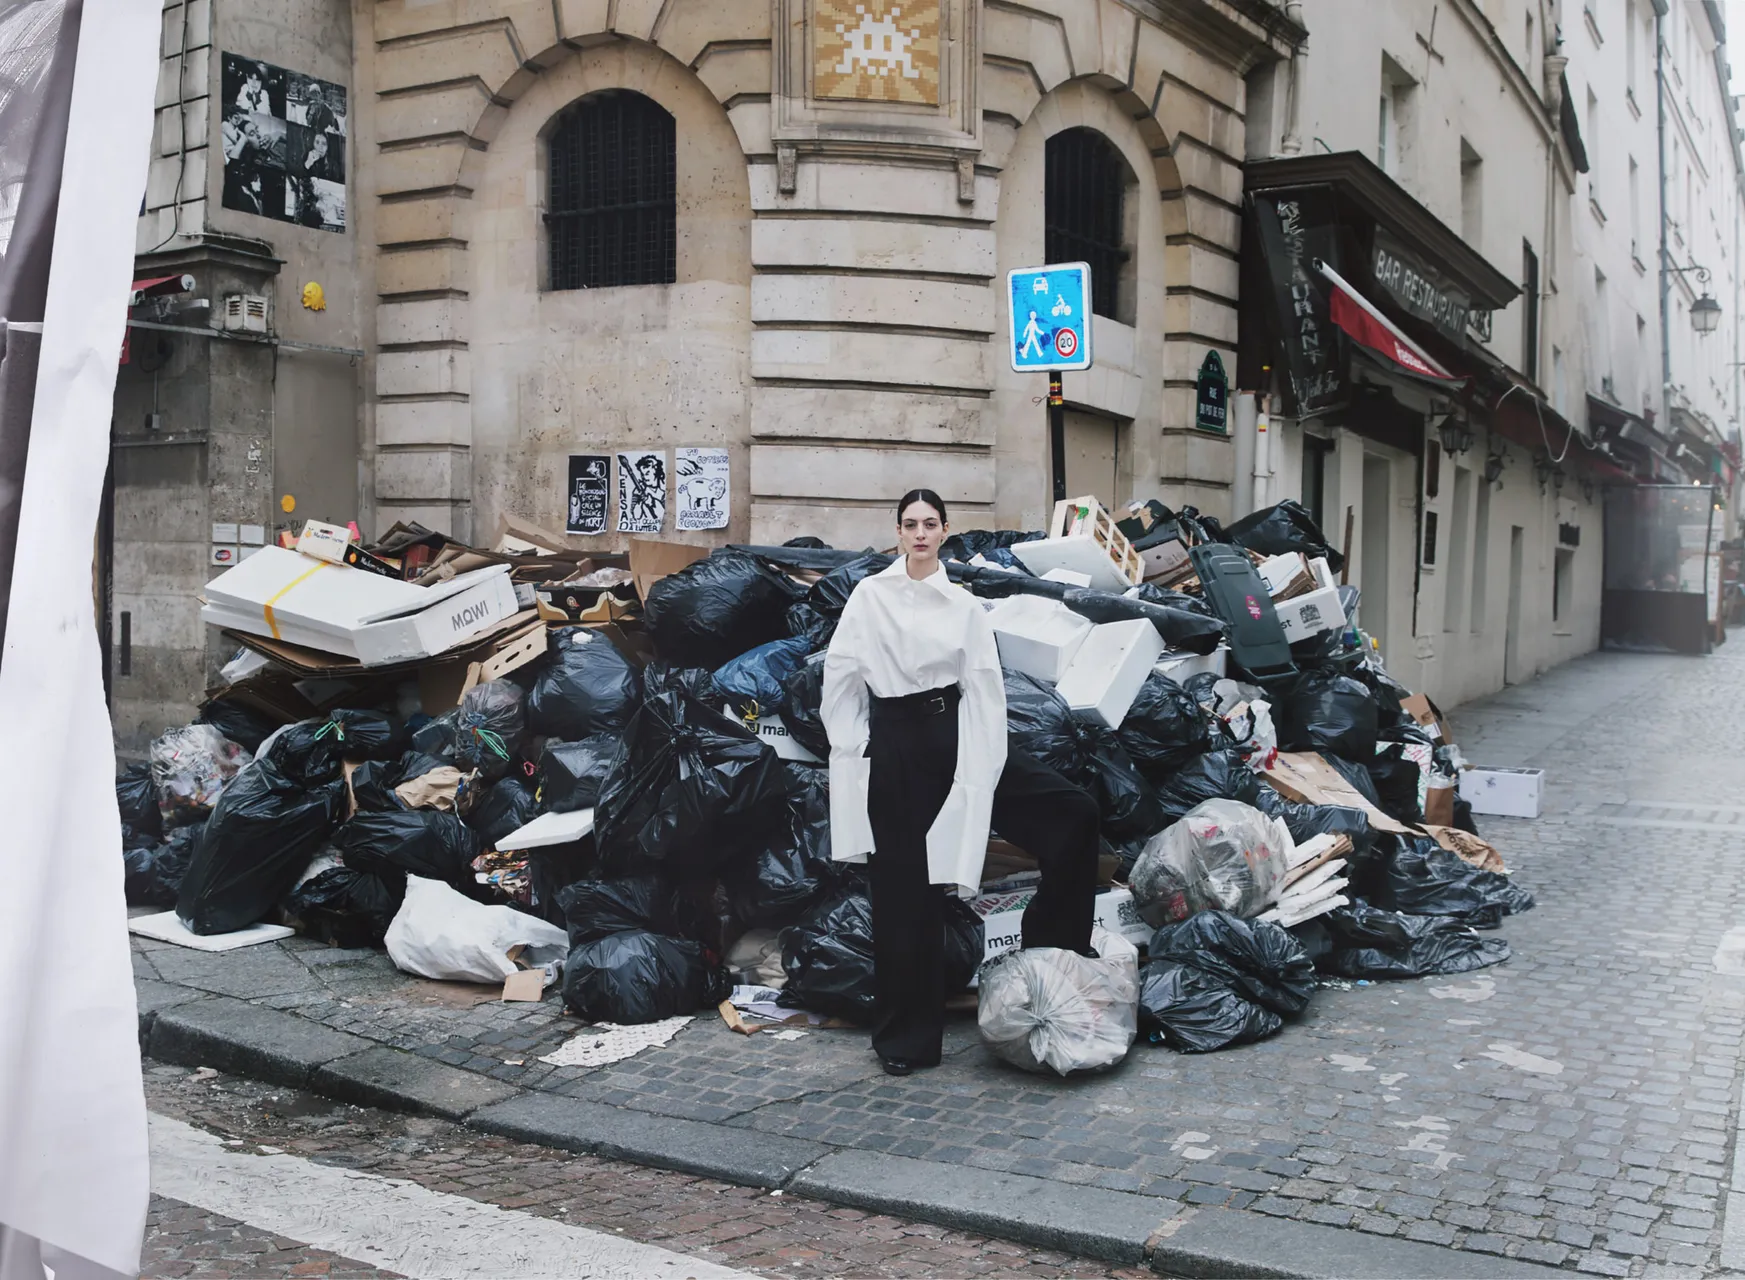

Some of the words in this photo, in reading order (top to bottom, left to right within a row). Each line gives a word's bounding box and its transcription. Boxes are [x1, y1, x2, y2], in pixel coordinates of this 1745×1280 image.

[1375, 249, 1400, 291] BAR
[1402, 269, 1465, 333] RESTAURANT
[1060, 337, 1073, 348] 20
[585, 517, 603, 527] MORT
